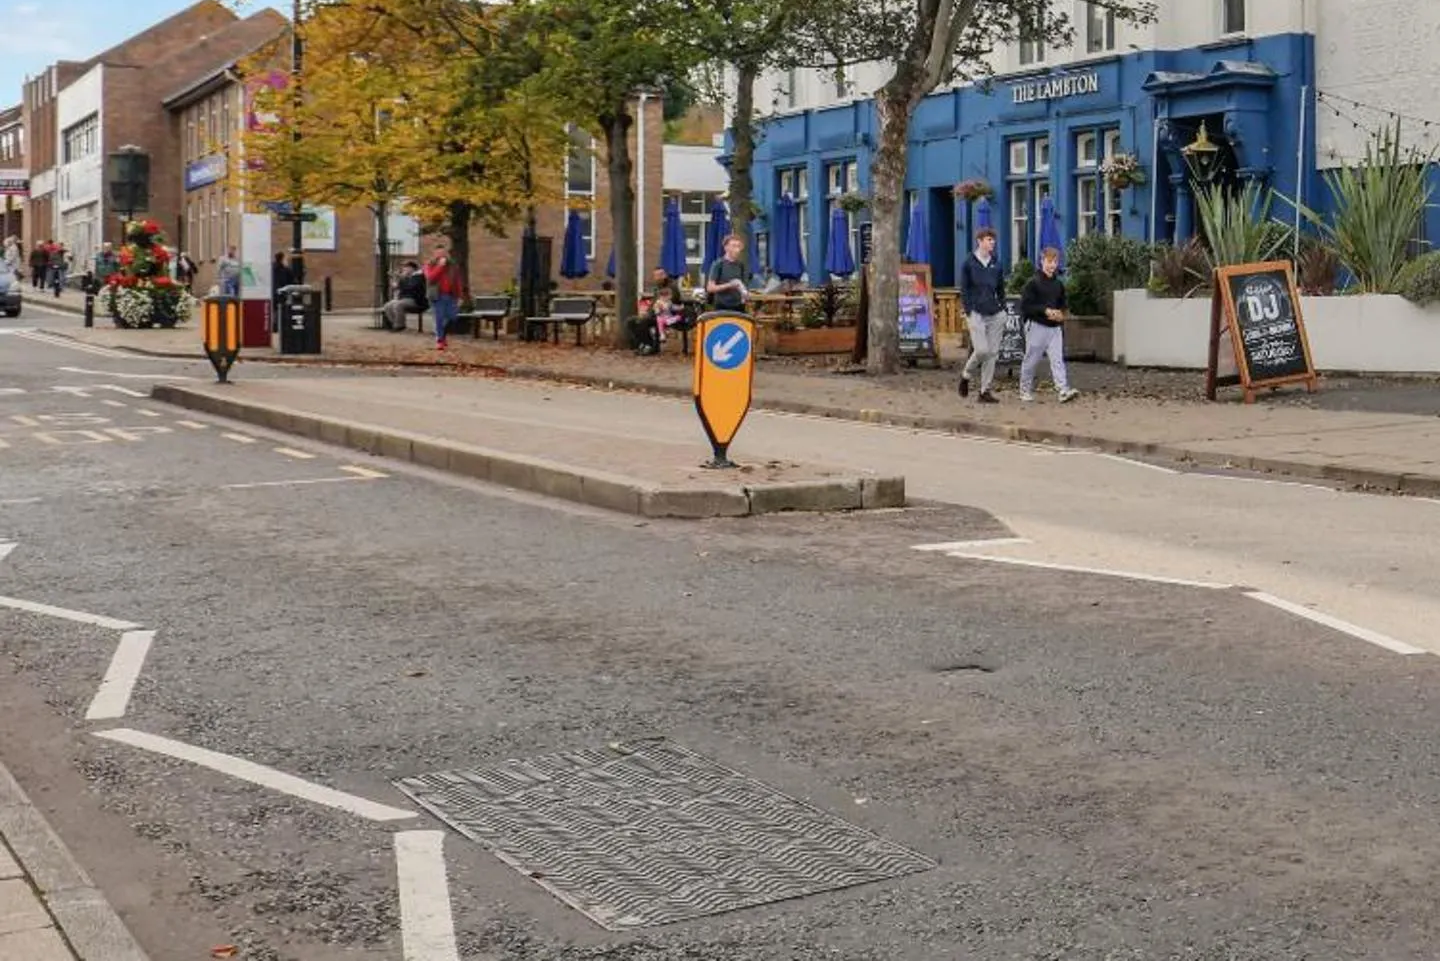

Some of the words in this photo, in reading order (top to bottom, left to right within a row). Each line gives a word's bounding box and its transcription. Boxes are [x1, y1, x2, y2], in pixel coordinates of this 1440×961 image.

[1012, 83, 1036, 103] THE
[1037, 73, 1098, 99] LAMBTON
[1246, 293, 1280, 322] DJ
